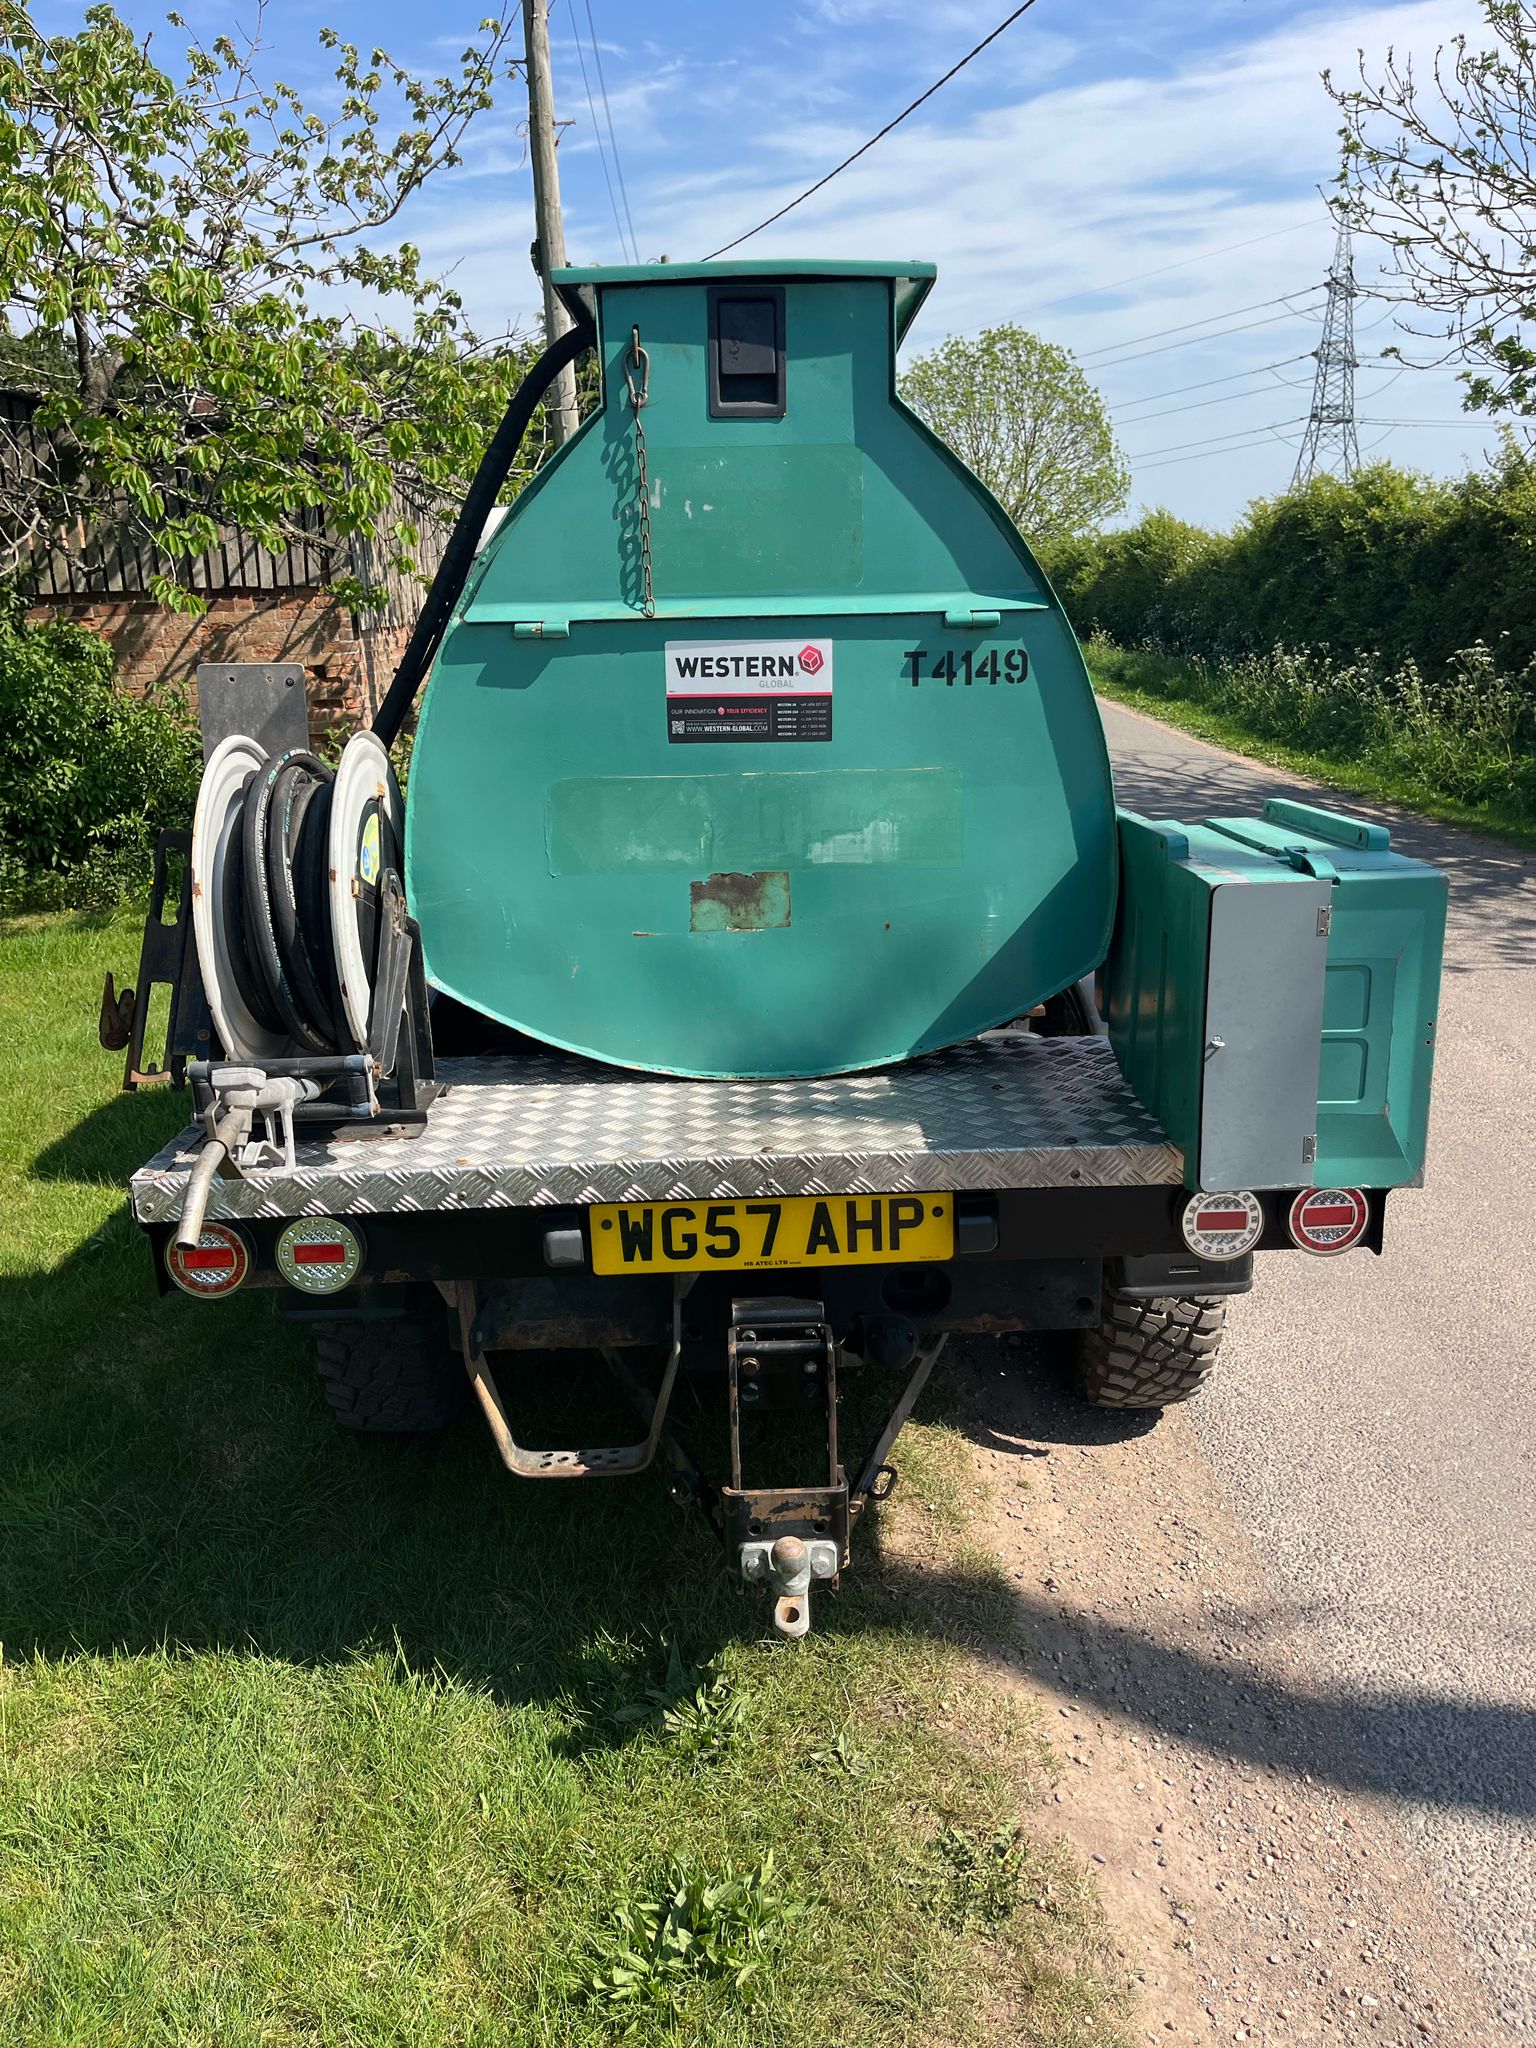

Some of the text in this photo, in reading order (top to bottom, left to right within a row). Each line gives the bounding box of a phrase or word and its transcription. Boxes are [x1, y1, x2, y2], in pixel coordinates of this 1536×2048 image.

[675, 656, 794, 678] WESTERN
[759, 680, 794, 688] GLOBAL
[618, 1197, 924, 1262] WG57 AHP
